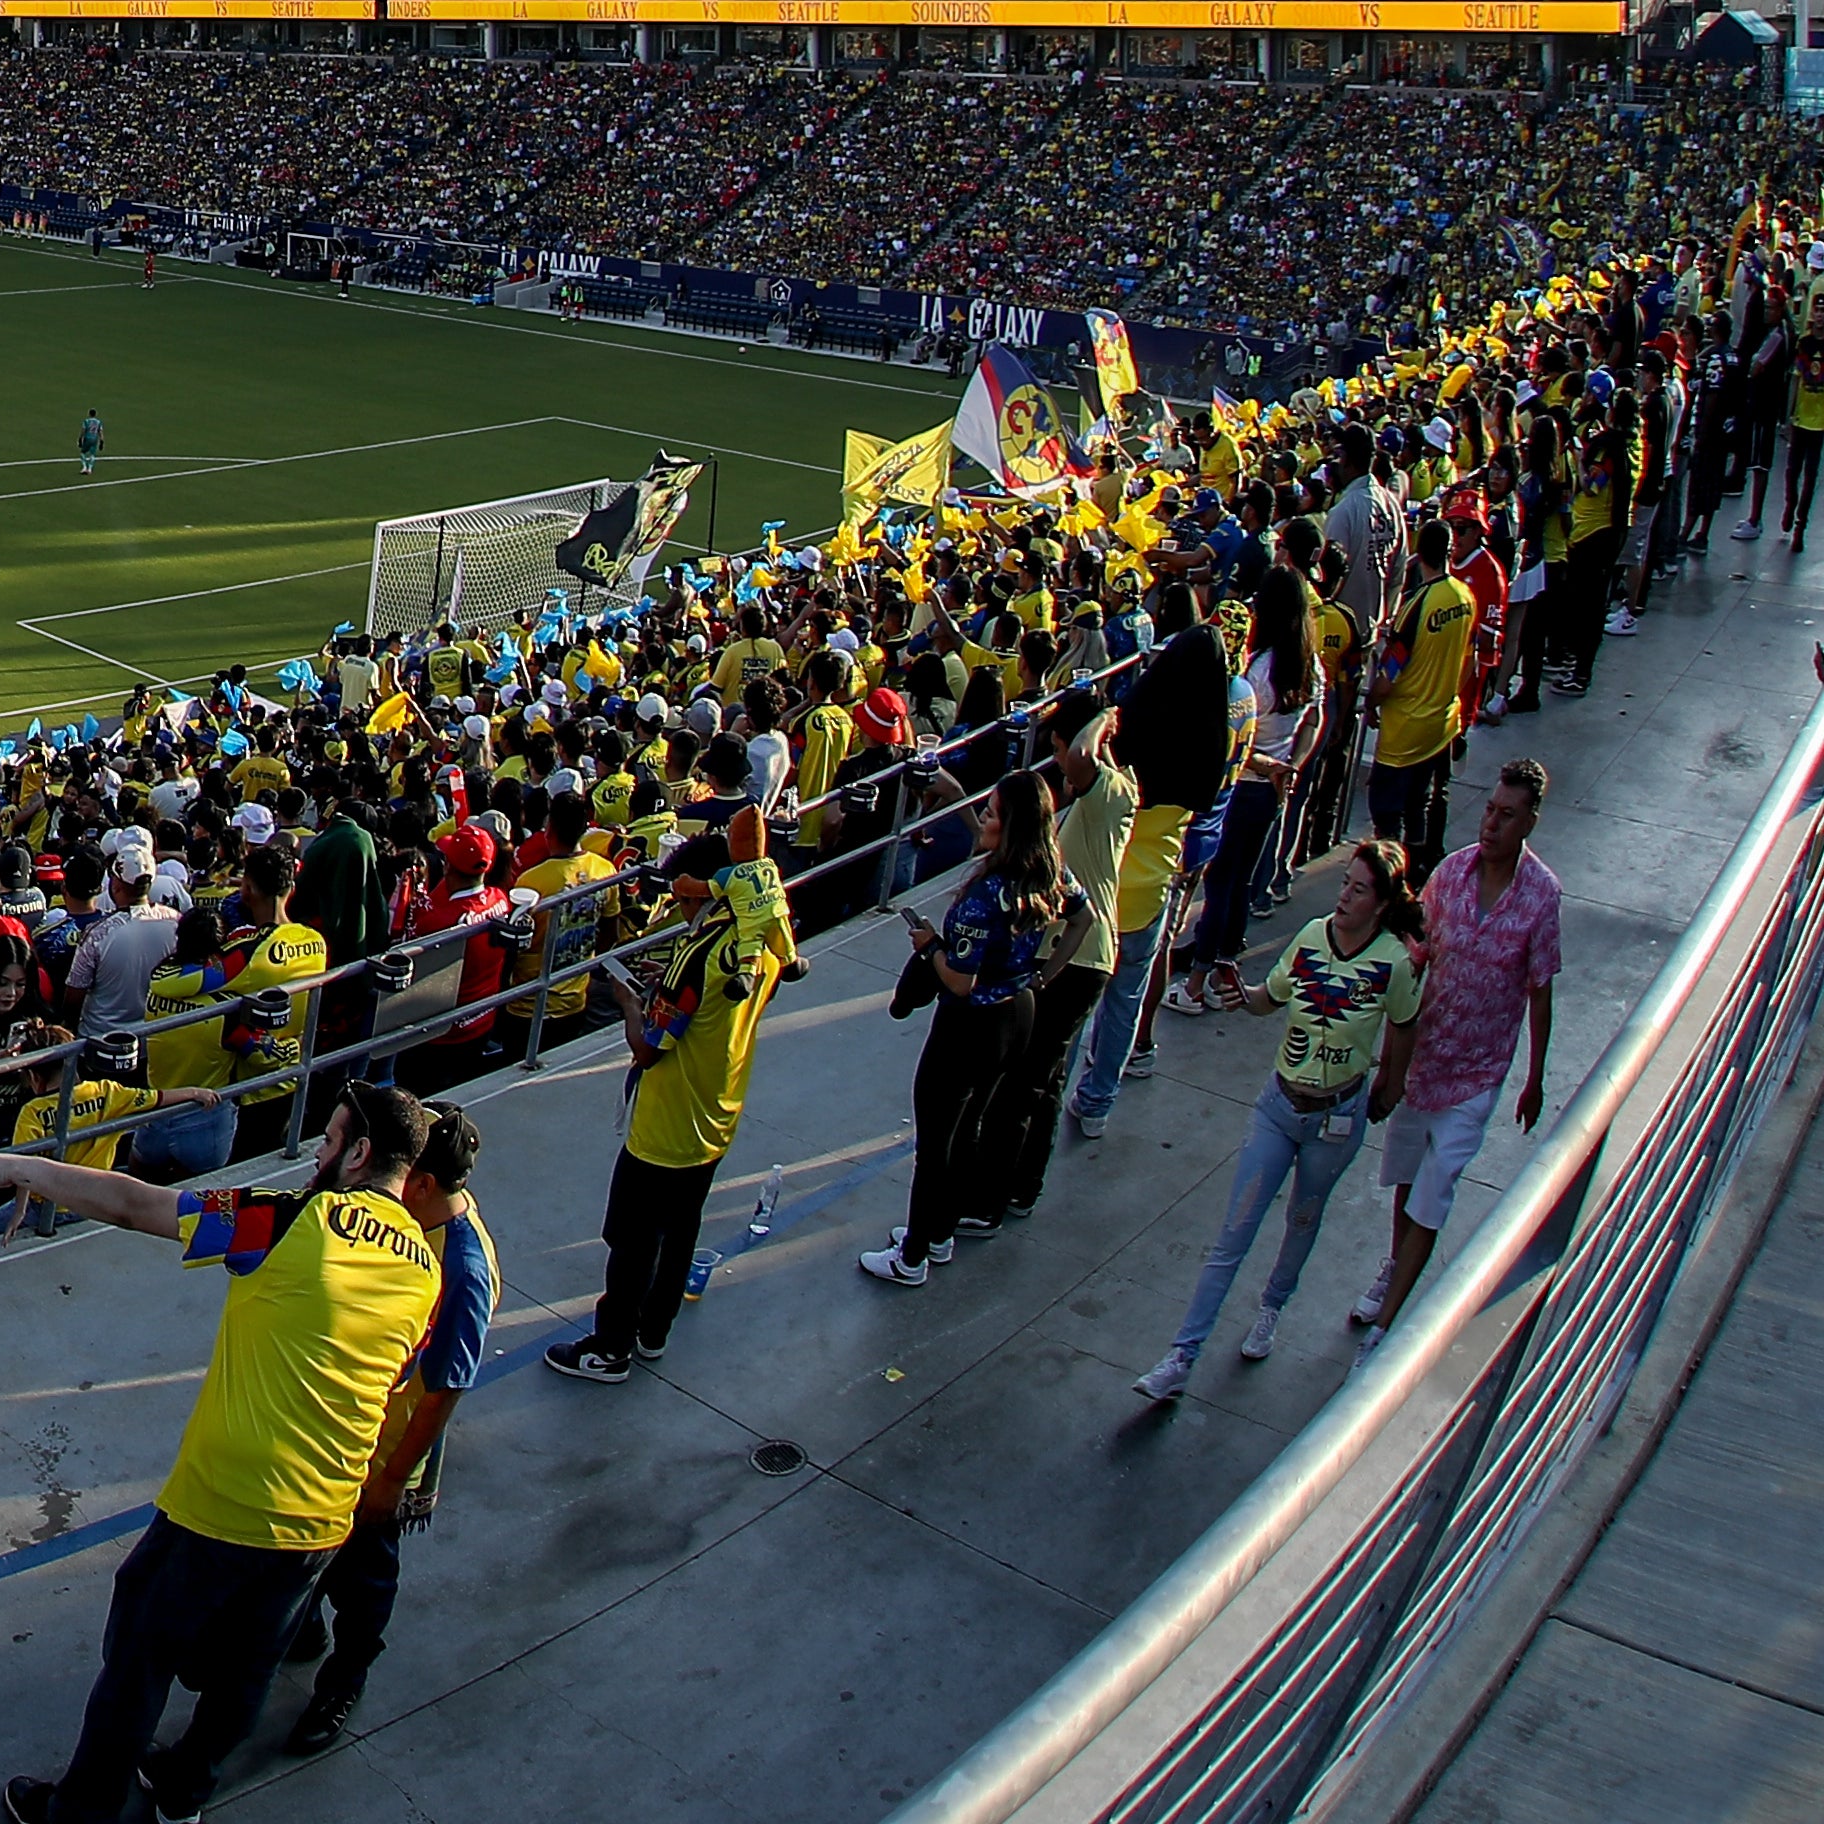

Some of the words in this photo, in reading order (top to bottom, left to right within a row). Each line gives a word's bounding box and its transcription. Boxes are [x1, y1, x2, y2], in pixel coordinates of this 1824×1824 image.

[70, 1, 82, 15] LA
[128, 1, 167, 15] GALAXY
[216, 1, 227, 16] VS
[272, 1, 314, 16] SEATTLE
[389, 1, 431, 17] UNDERS
[513, 2, 528, 18] LA
[587, 2, 639, 19] GALAXY
[703, 2, 718, 20] VS
[778, 2, 839, 22] SEATTLE
[911, 2, 991, 23] SOUNDERS
[1108, 4, 1128, 24] LA
[1210, 4, 1276, 26] GALAXY
[1360, 4, 1380, 27] VS
[1464, 5, 1539, 29] SEATTLE
[920, 296, 943, 327] LA
[968, 302, 1044, 346] GALAXY
[1428, 601, 1473, 633] Corona
[654, 799, 665, 812] P
[752, 867, 774, 894] 12
[1315, 1045, 1353, 1066] AT&T
[328, 1202, 433, 1275] Corona
